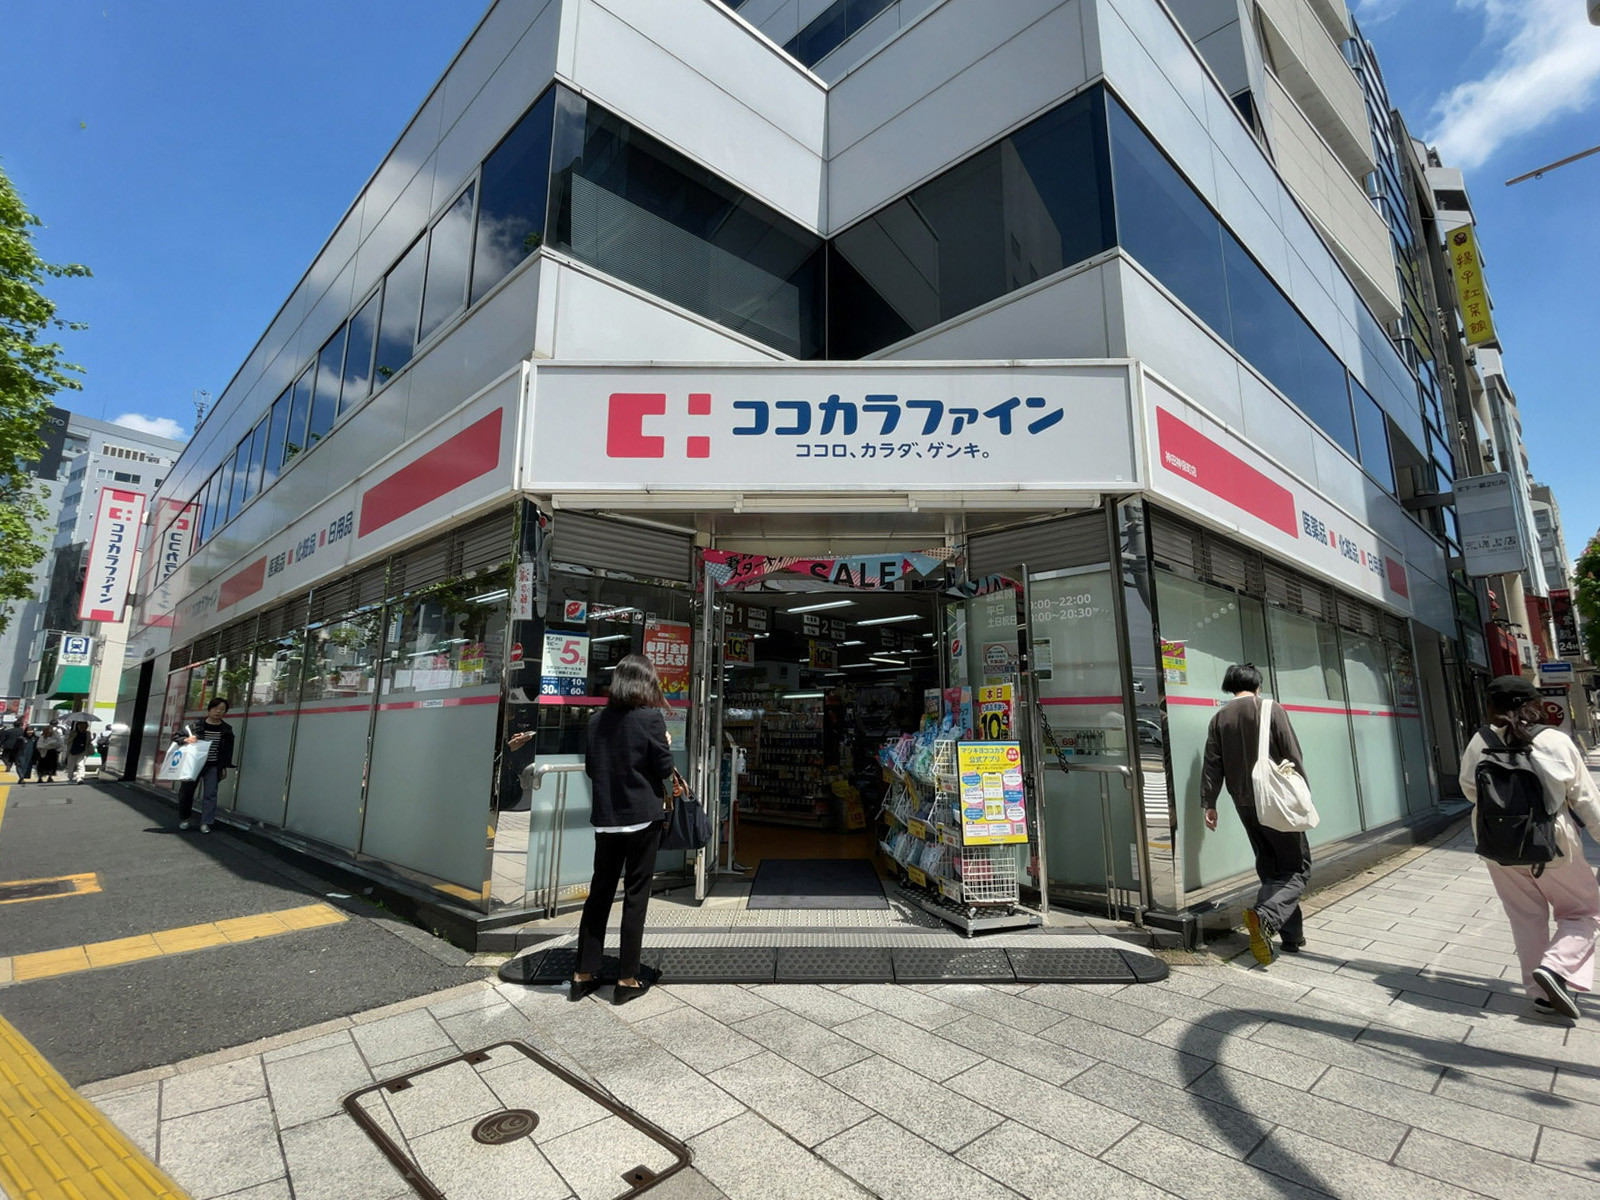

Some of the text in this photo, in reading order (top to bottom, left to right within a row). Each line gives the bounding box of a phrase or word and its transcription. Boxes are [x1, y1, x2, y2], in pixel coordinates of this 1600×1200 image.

[732, 394, 1064, 436] ココカラファイン
[796, 442, 990, 460] ココロ、カラダ、ゲンキ。
[268, 510, 354, 578] 医薬品 化粧品 日用品
[1302, 510, 1328, 546] 医薬品
[1339, 534, 1360, 564] 化粧品
[100, 522, 125, 604] ココカラファイン
[810, 562, 897, 588] SALE
[737, 607, 743, 623] 1
[986, 604, 1005, 615] 平日
[821, 620, 829, 634] 2
[986, 687, 1003, 700] 本日
